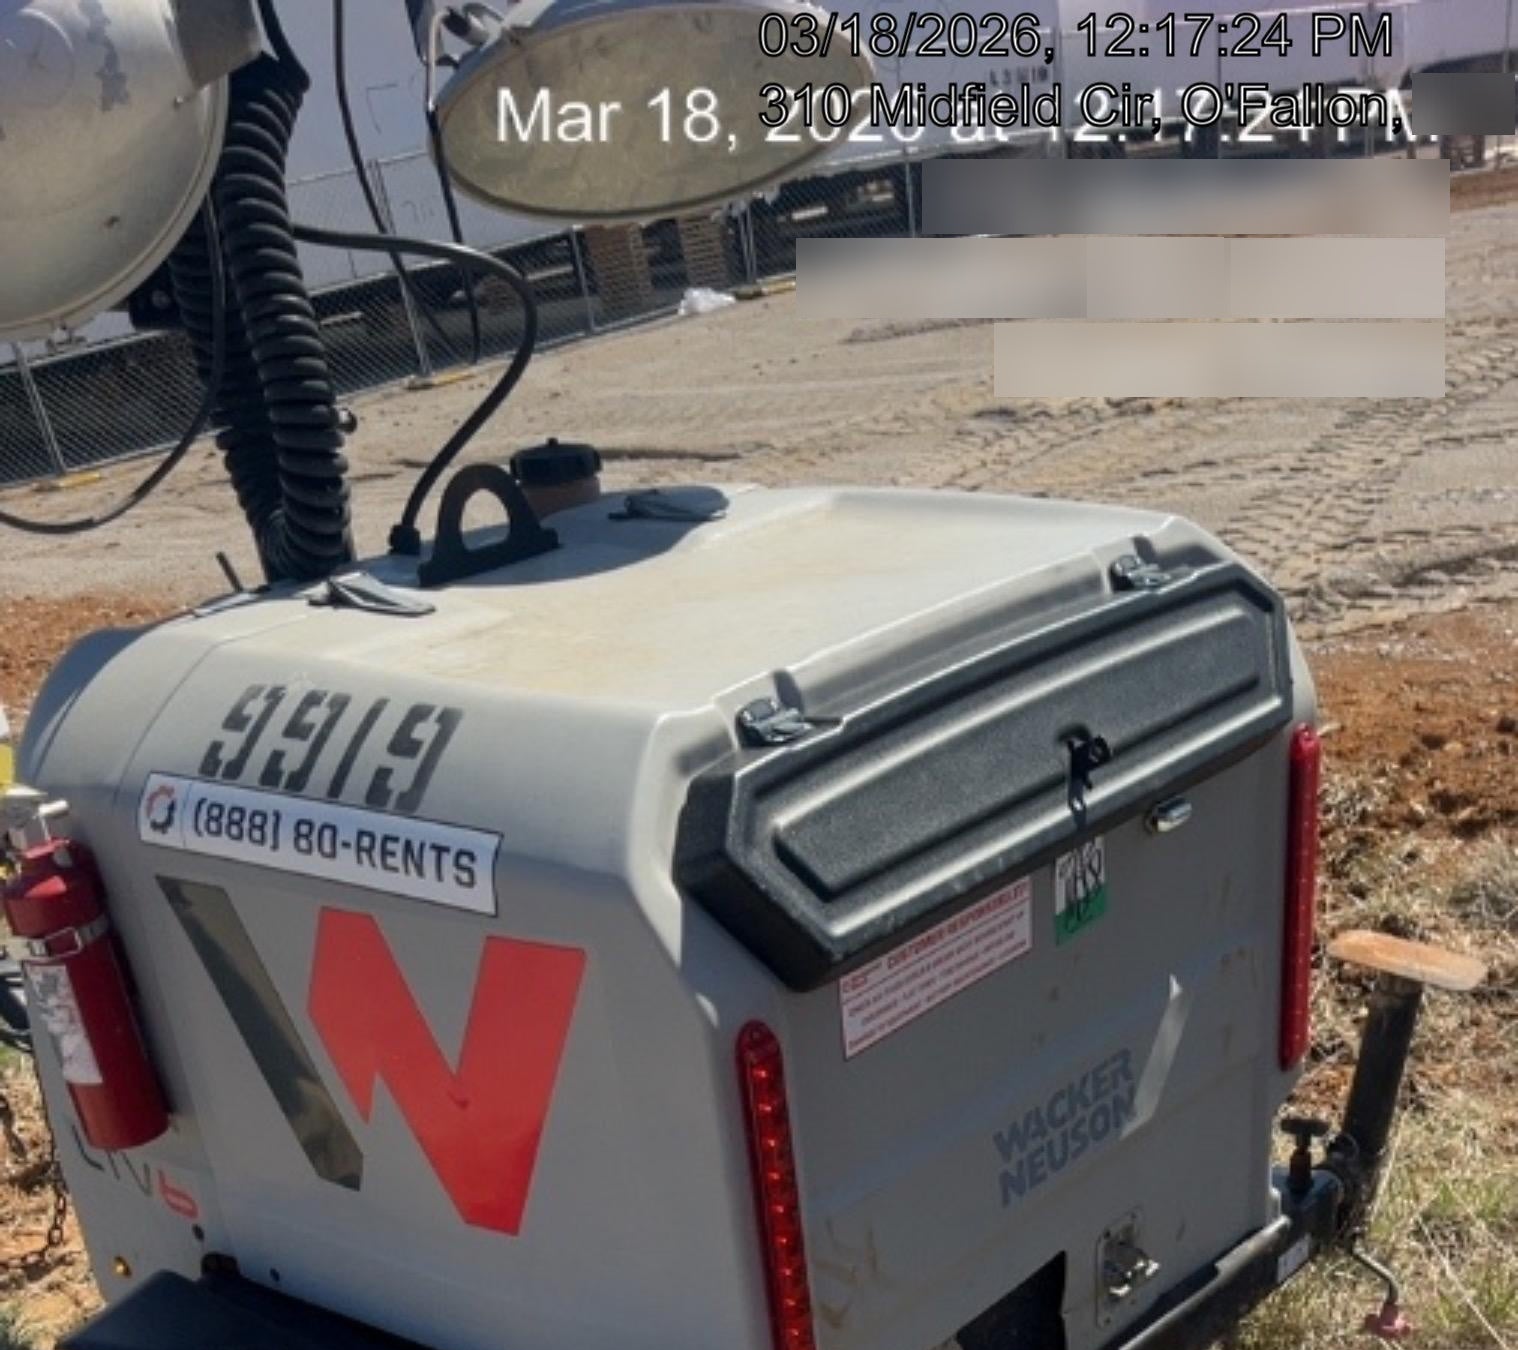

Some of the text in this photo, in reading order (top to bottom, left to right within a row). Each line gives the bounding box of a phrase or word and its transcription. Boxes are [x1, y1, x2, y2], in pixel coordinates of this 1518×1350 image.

[198, 684, 465, 813] 9919
[293, 817, 477, 889] 80-RENTS
[993, 1047, 1133, 1164] WACKER
[1000, 1084, 1138, 1208] NEUSON
